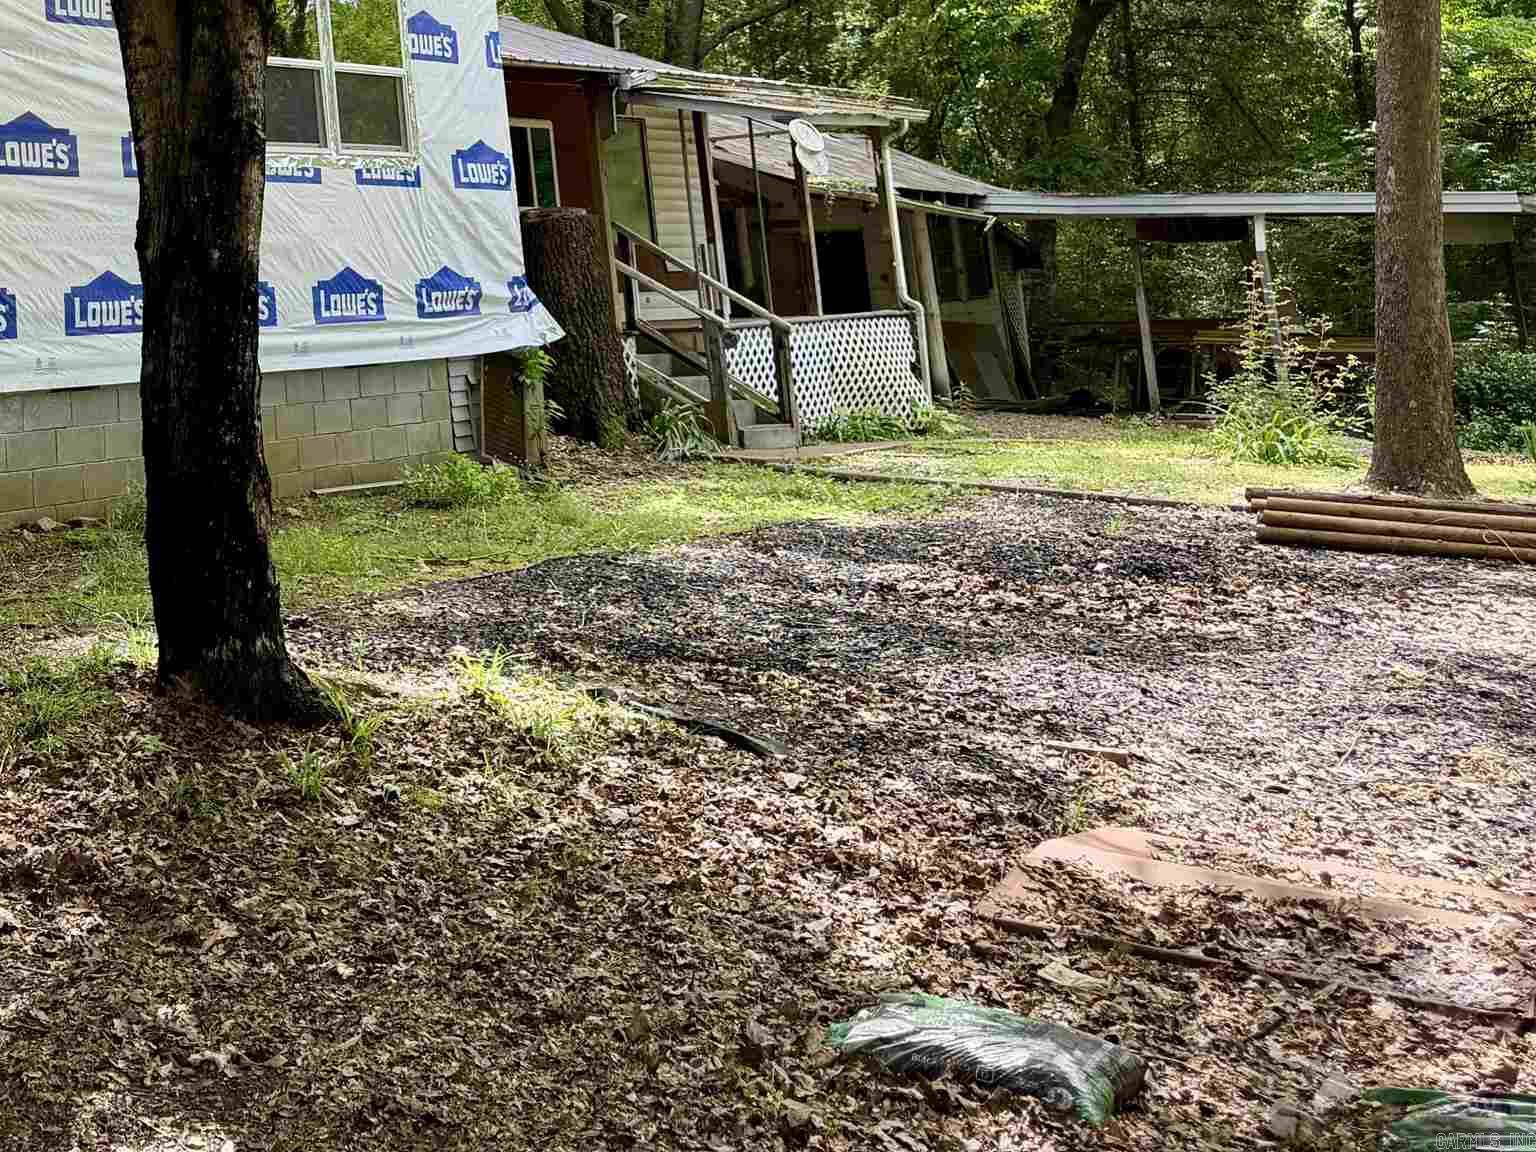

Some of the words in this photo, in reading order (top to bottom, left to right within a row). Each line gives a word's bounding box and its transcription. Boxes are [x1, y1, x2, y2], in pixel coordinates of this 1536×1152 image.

[408, 33, 452, 58] OWE'S
[459, 159, 506, 186] LOWE'S
[320, 289, 377, 317] LOWE'S
[421, 287, 474, 313] LOWE'S
